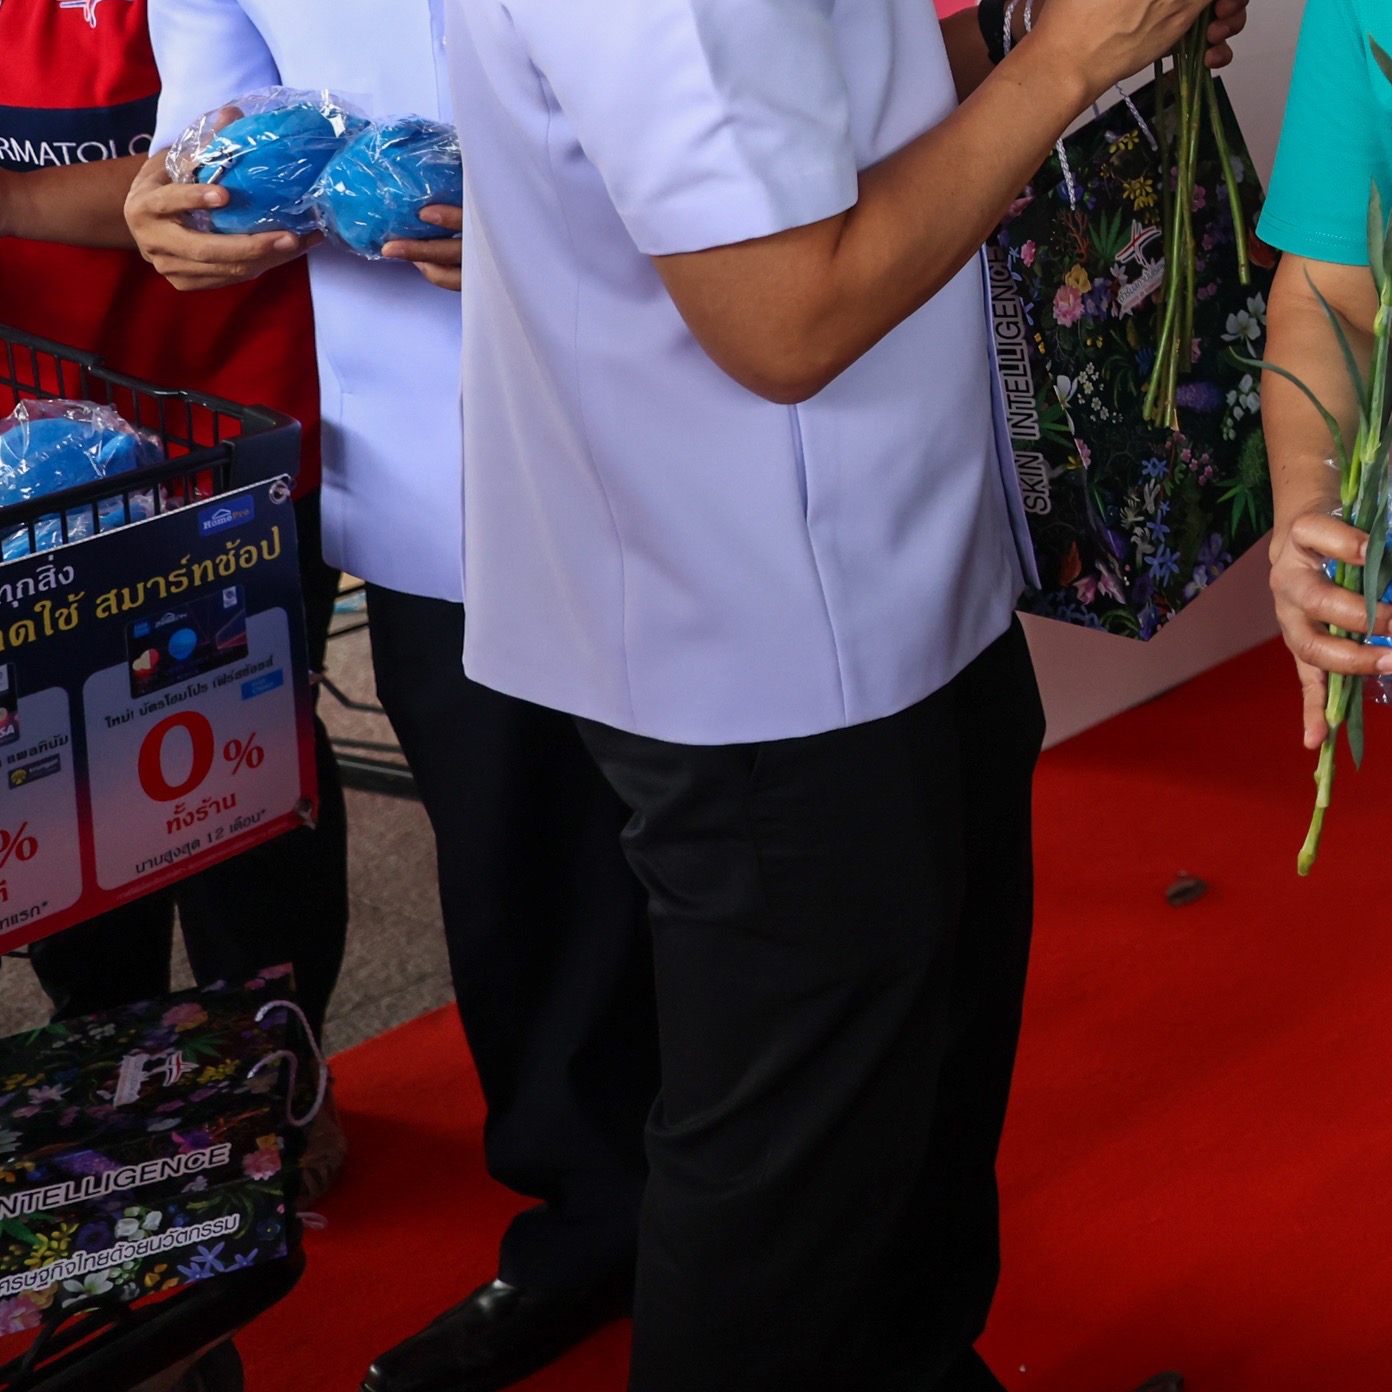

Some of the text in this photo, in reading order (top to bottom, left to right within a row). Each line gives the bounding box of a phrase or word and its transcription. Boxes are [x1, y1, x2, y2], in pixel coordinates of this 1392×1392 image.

[1016, 451, 1049, 513] SKIN
[202, 508, 250, 530] HomePro
[95, 525, 282, 620] สมาร์ทช้อป
[166, 792, 237, 834] ทั้งร้าน
[135, 838, 201, 874] นานสูงสุด
[207, 827, 225, 844] 12
